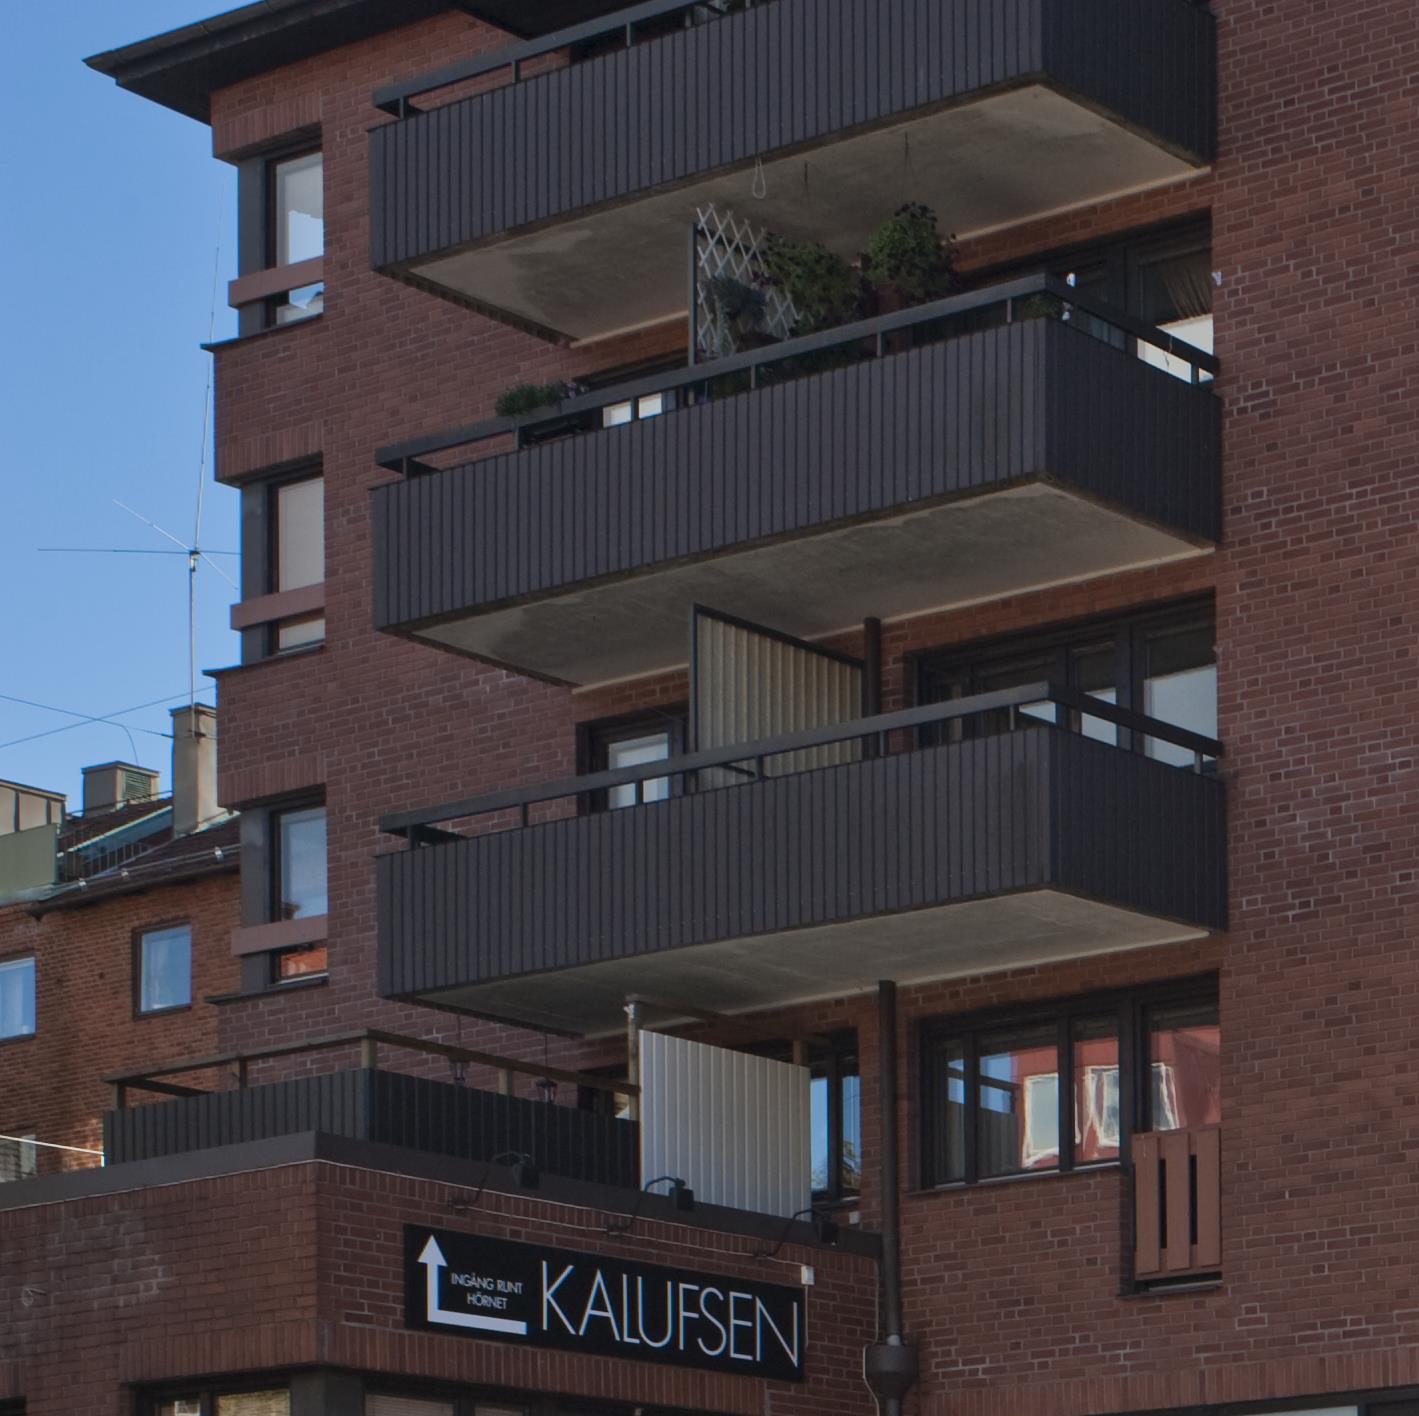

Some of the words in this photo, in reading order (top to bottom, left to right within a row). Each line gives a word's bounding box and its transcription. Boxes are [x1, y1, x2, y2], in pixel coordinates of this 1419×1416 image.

[451, 1272, 494, 1291] INGÅNG
[497, 1279, 523, 1295] RUNT
[467, 1291, 508, 1310] HÖRNET
[541, 1260, 799, 1368] KALUFSEN
